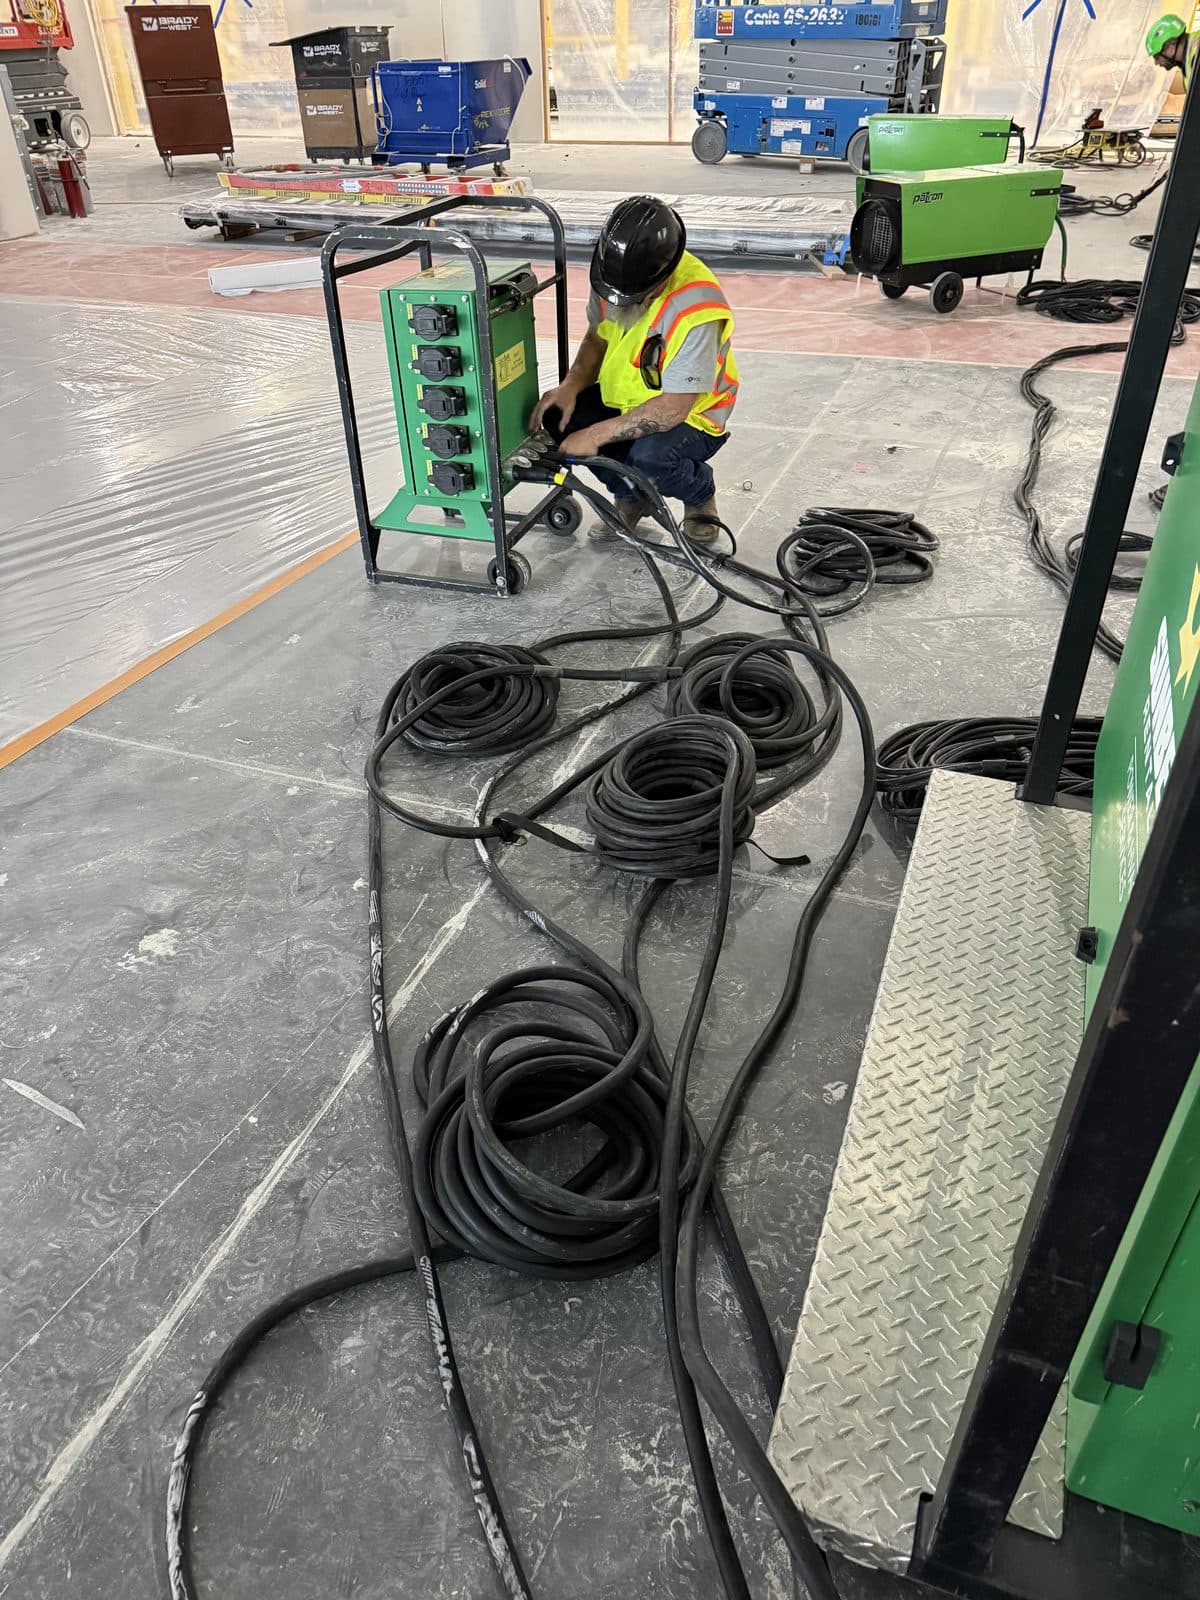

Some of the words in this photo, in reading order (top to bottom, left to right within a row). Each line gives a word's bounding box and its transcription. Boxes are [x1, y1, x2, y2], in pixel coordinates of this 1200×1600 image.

[158, 16, 199, 25] BRADY
[313, 43, 341, 53] BRADY
[912, 191, 944, 205] patron
